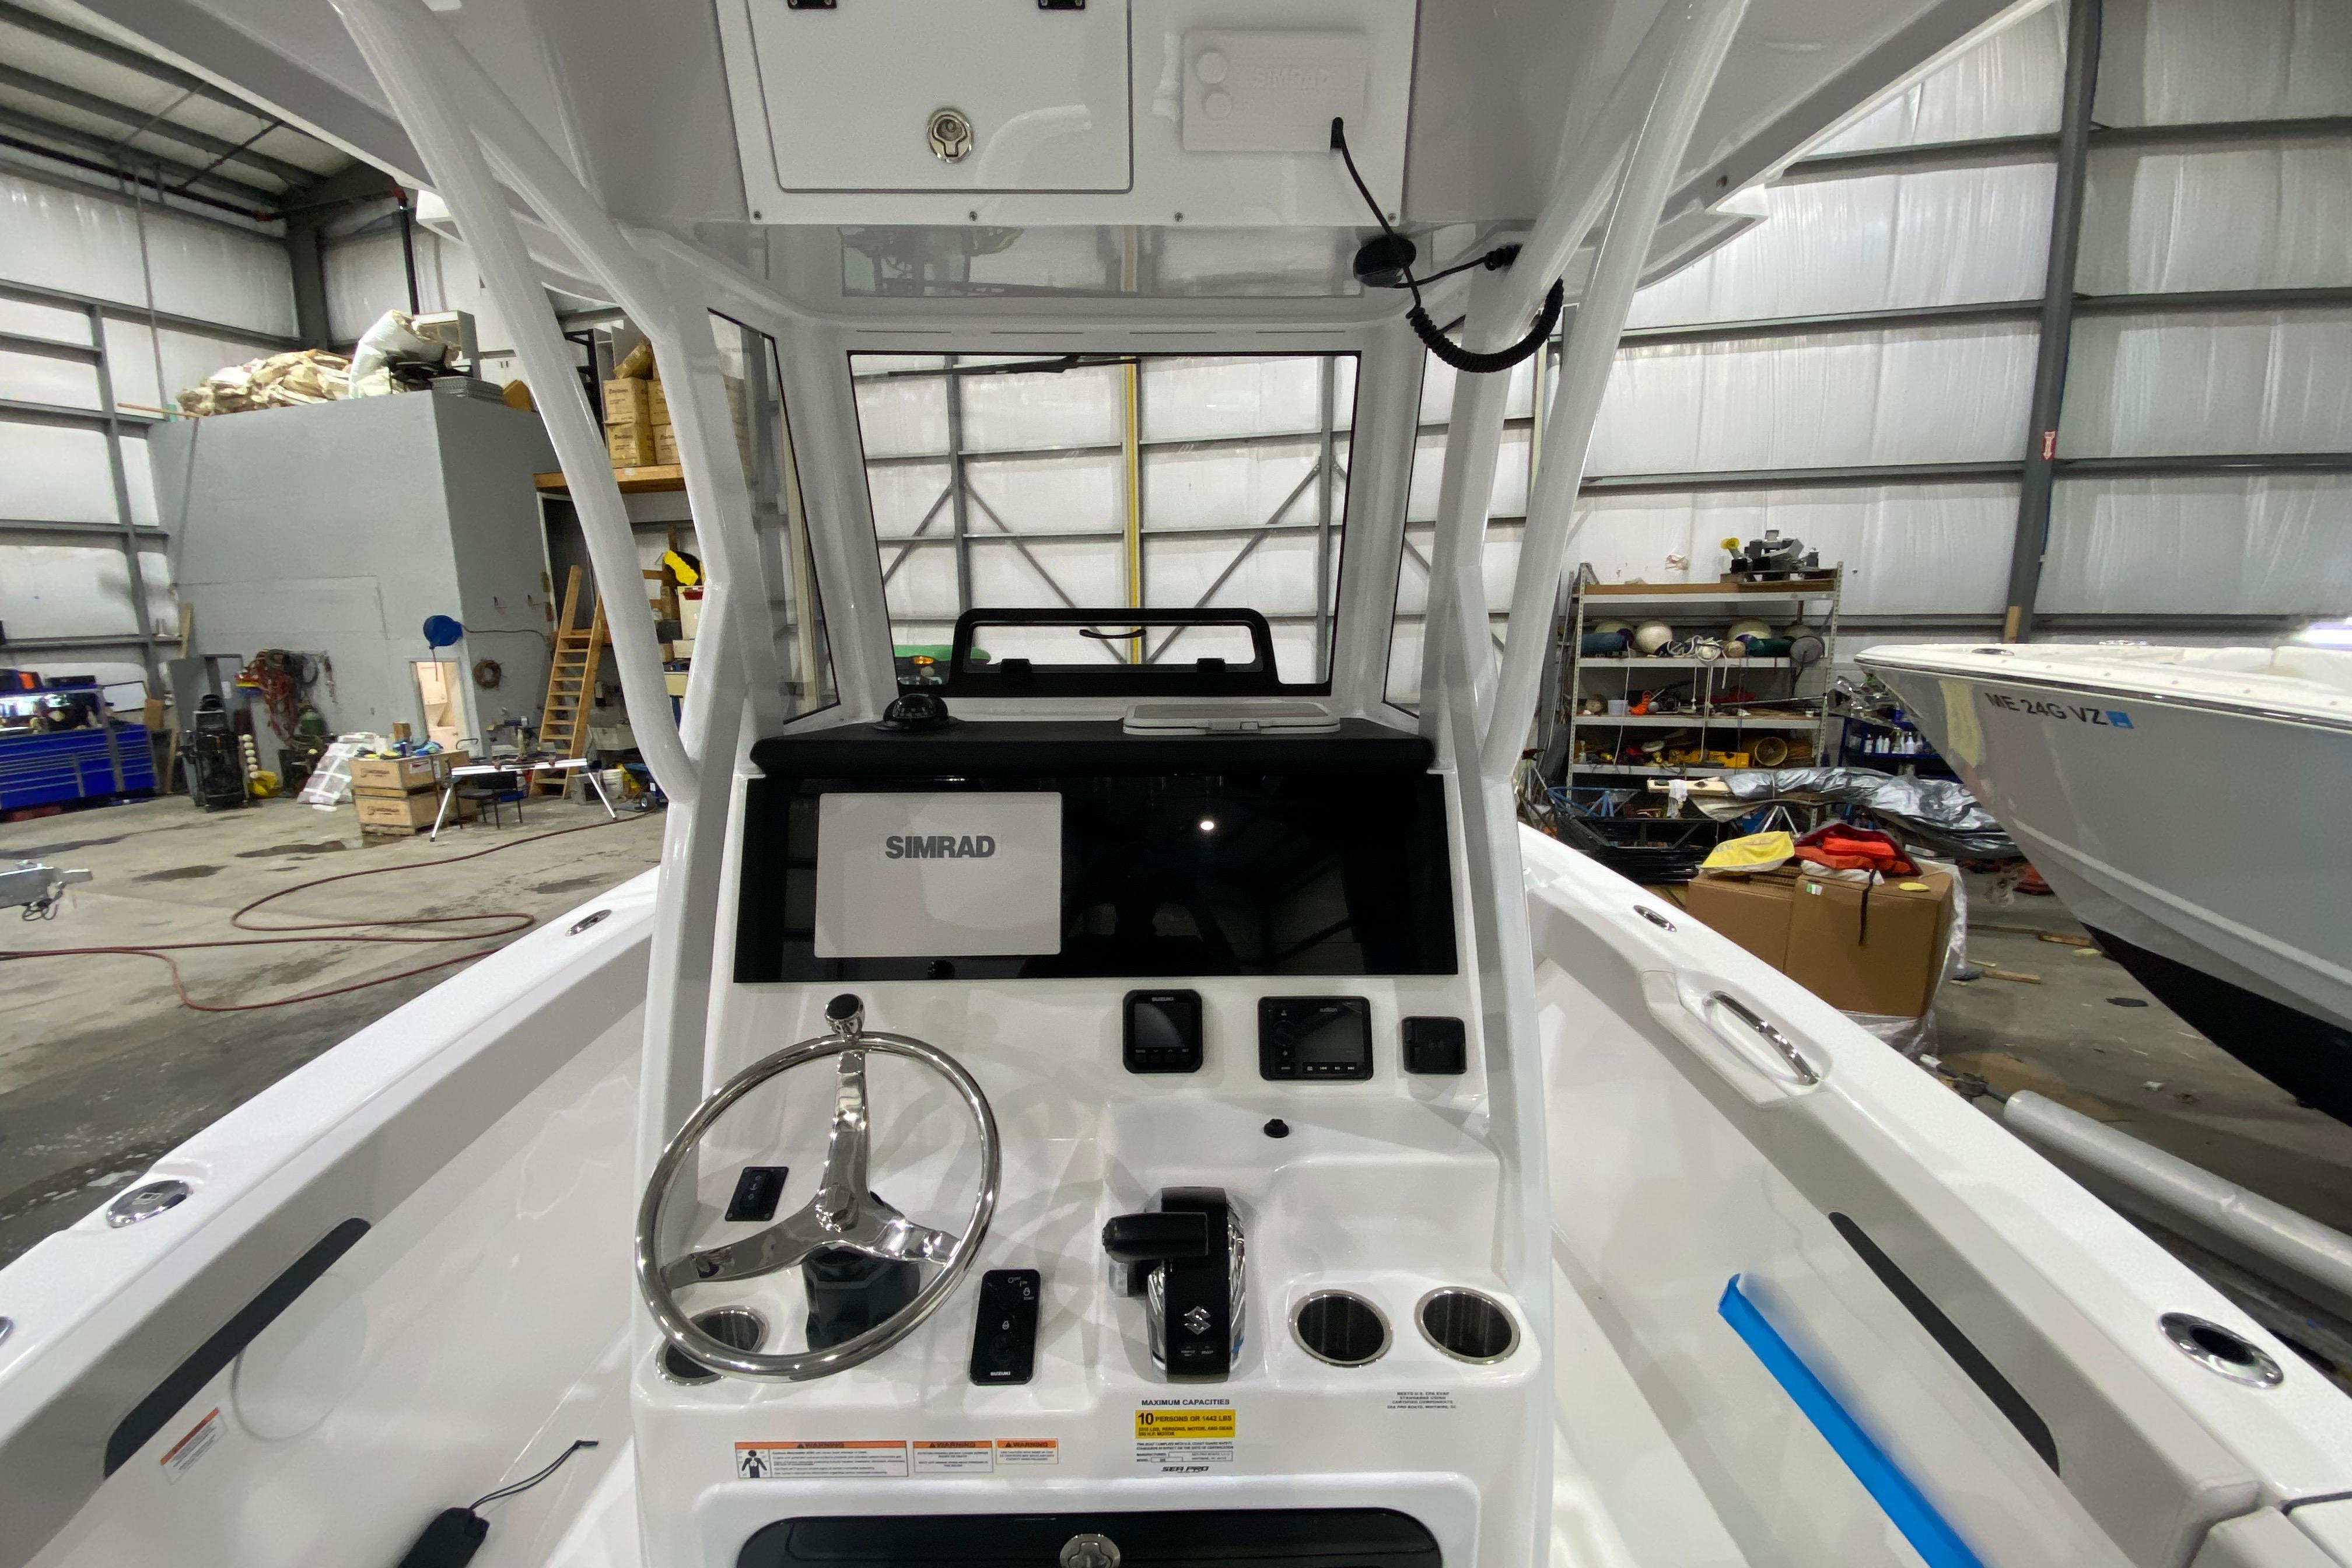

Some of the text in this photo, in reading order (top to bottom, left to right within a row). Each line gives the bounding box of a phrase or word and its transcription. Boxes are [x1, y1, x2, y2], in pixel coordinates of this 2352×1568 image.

[1985, 692, 2109, 725] ME 24G VZ
[886, 835, 995, 859] SIMRAD
[1138, 1413, 1154, 1425] 10
